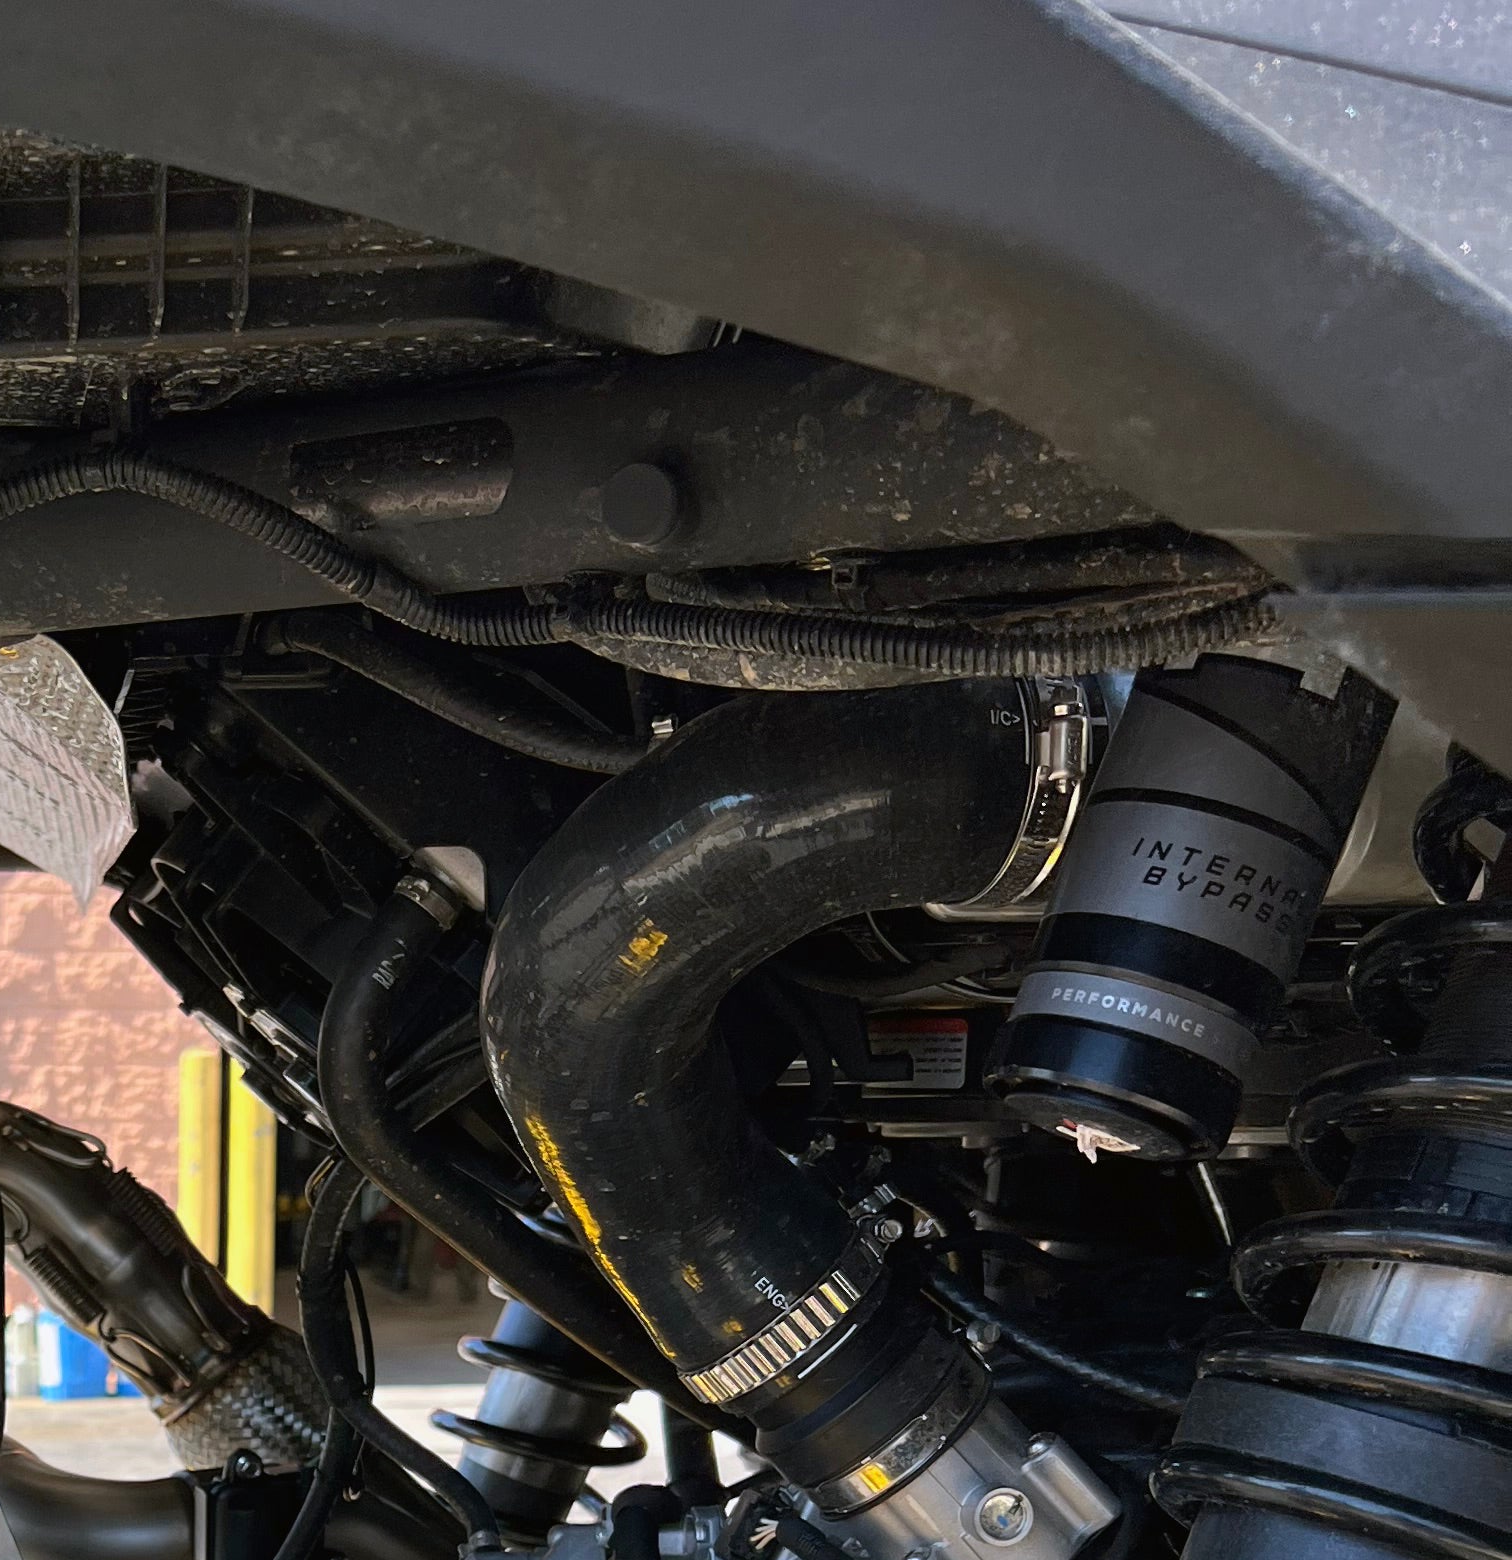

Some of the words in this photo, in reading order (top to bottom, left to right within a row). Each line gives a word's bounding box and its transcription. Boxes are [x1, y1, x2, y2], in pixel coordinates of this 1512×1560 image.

[1132, 837, 1303, 909] INTERNA
[1143, 865, 1292, 934] BYPASS
[1051, 987, 1206, 1038] PERFORMANCE
